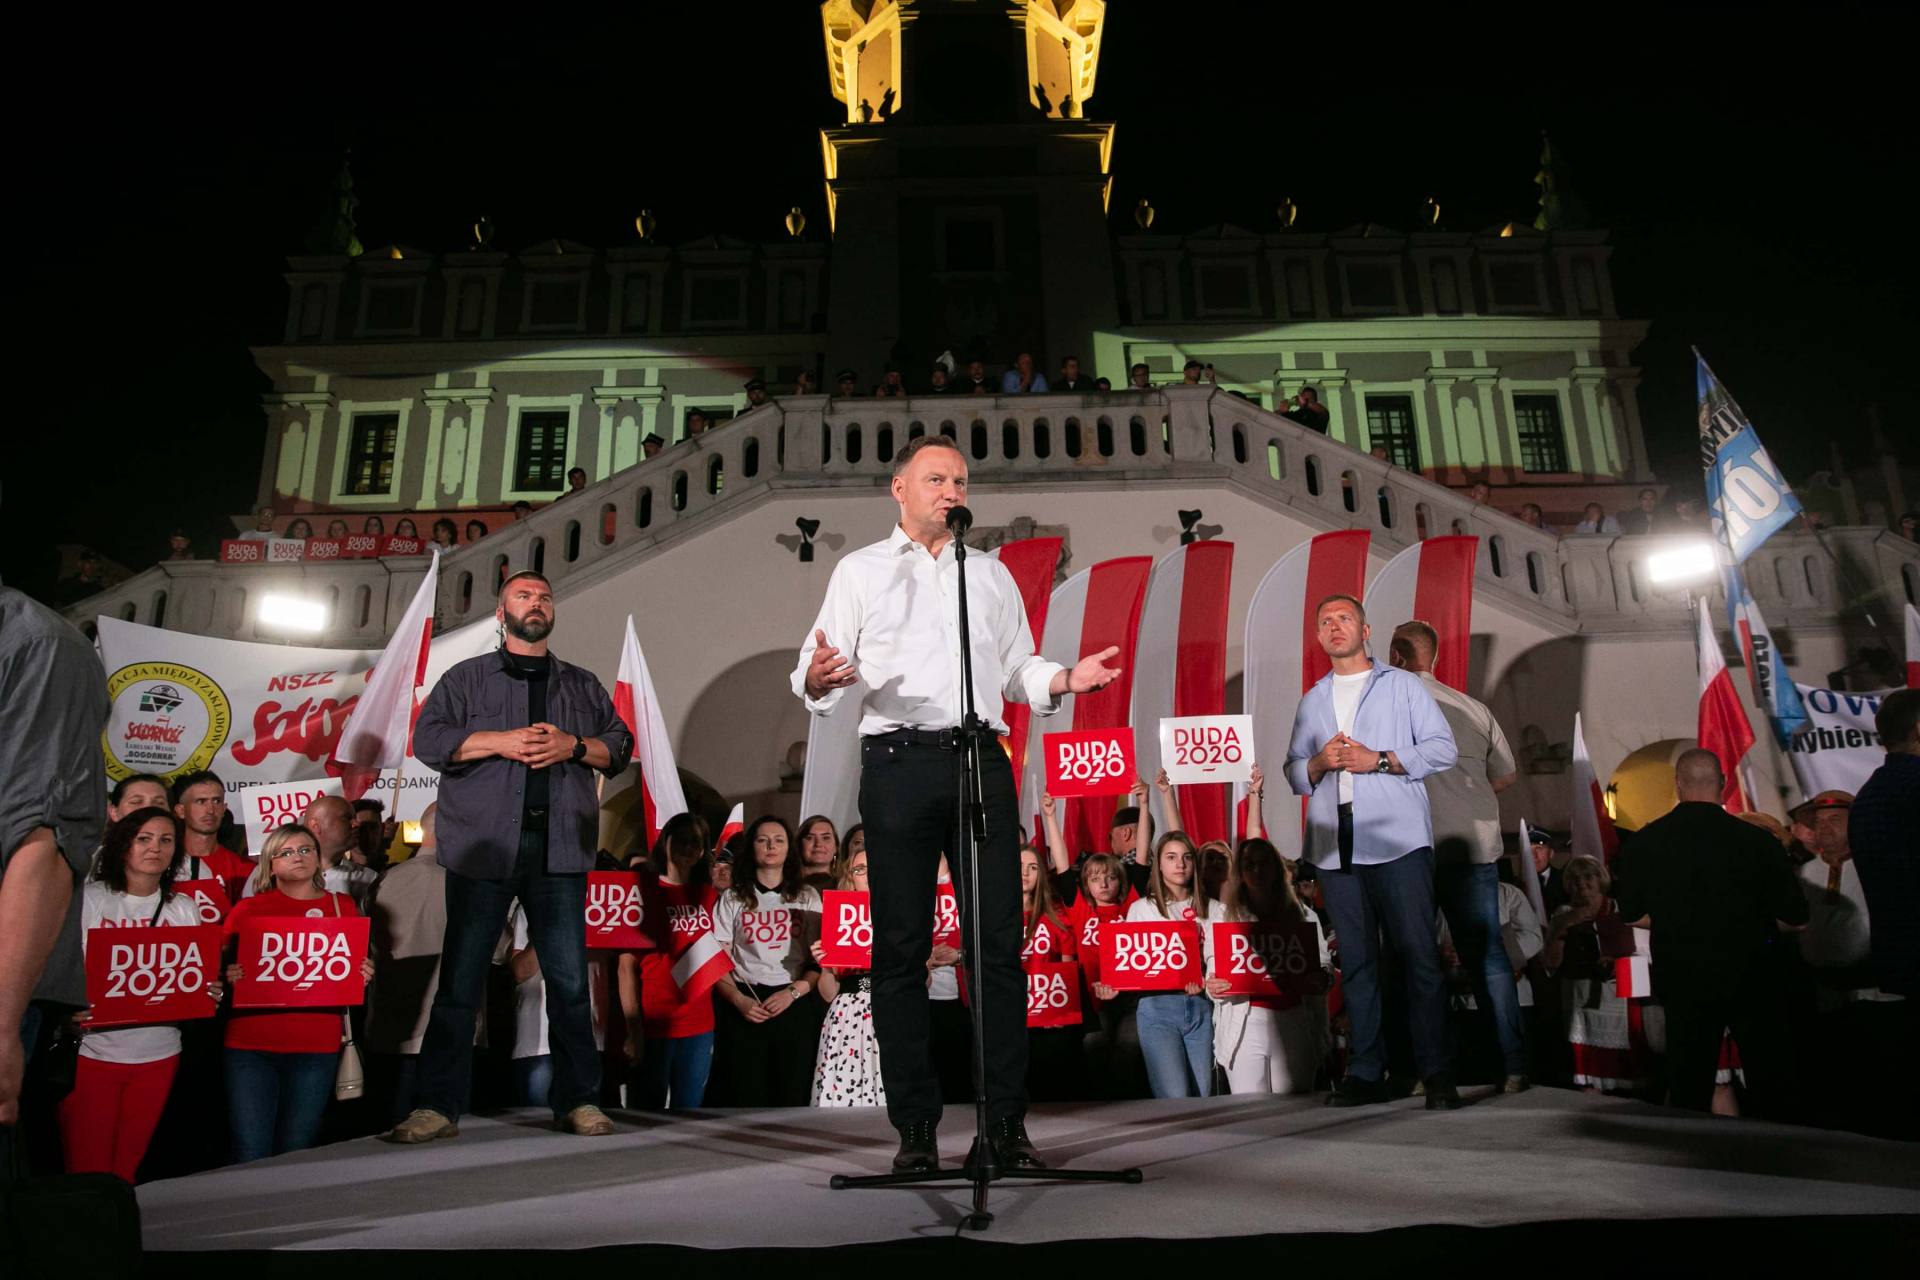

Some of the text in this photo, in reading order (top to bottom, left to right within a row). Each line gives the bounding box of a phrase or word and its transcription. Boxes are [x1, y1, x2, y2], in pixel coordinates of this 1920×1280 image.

[227, 551, 258, 560] 2020
[228, 544, 258, 553] DUDA
[268, 670, 337, 692] NSZZ
[1174, 727, 1240, 747] DUDA
[1059, 739, 1123, 762] DUDA
[1175, 745, 1242, 766] 2020
[1058, 758, 1126, 781] 2020
[666, 904, 709, 919] DUDA
[670, 915, 712, 932] 2020
[261, 932, 352, 957] DUDA
[1115, 932, 1186, 953] DUDA
[1231, 934, 1305, 954] DUDA
[110, 942, 203, 971] DUDA
[1115, 949, 1188, 971] 2020
[1230, 953, 1307, 975] 2020
[256, 955, 351, 982] 2020
[105, 966, 203, 998] 2020
